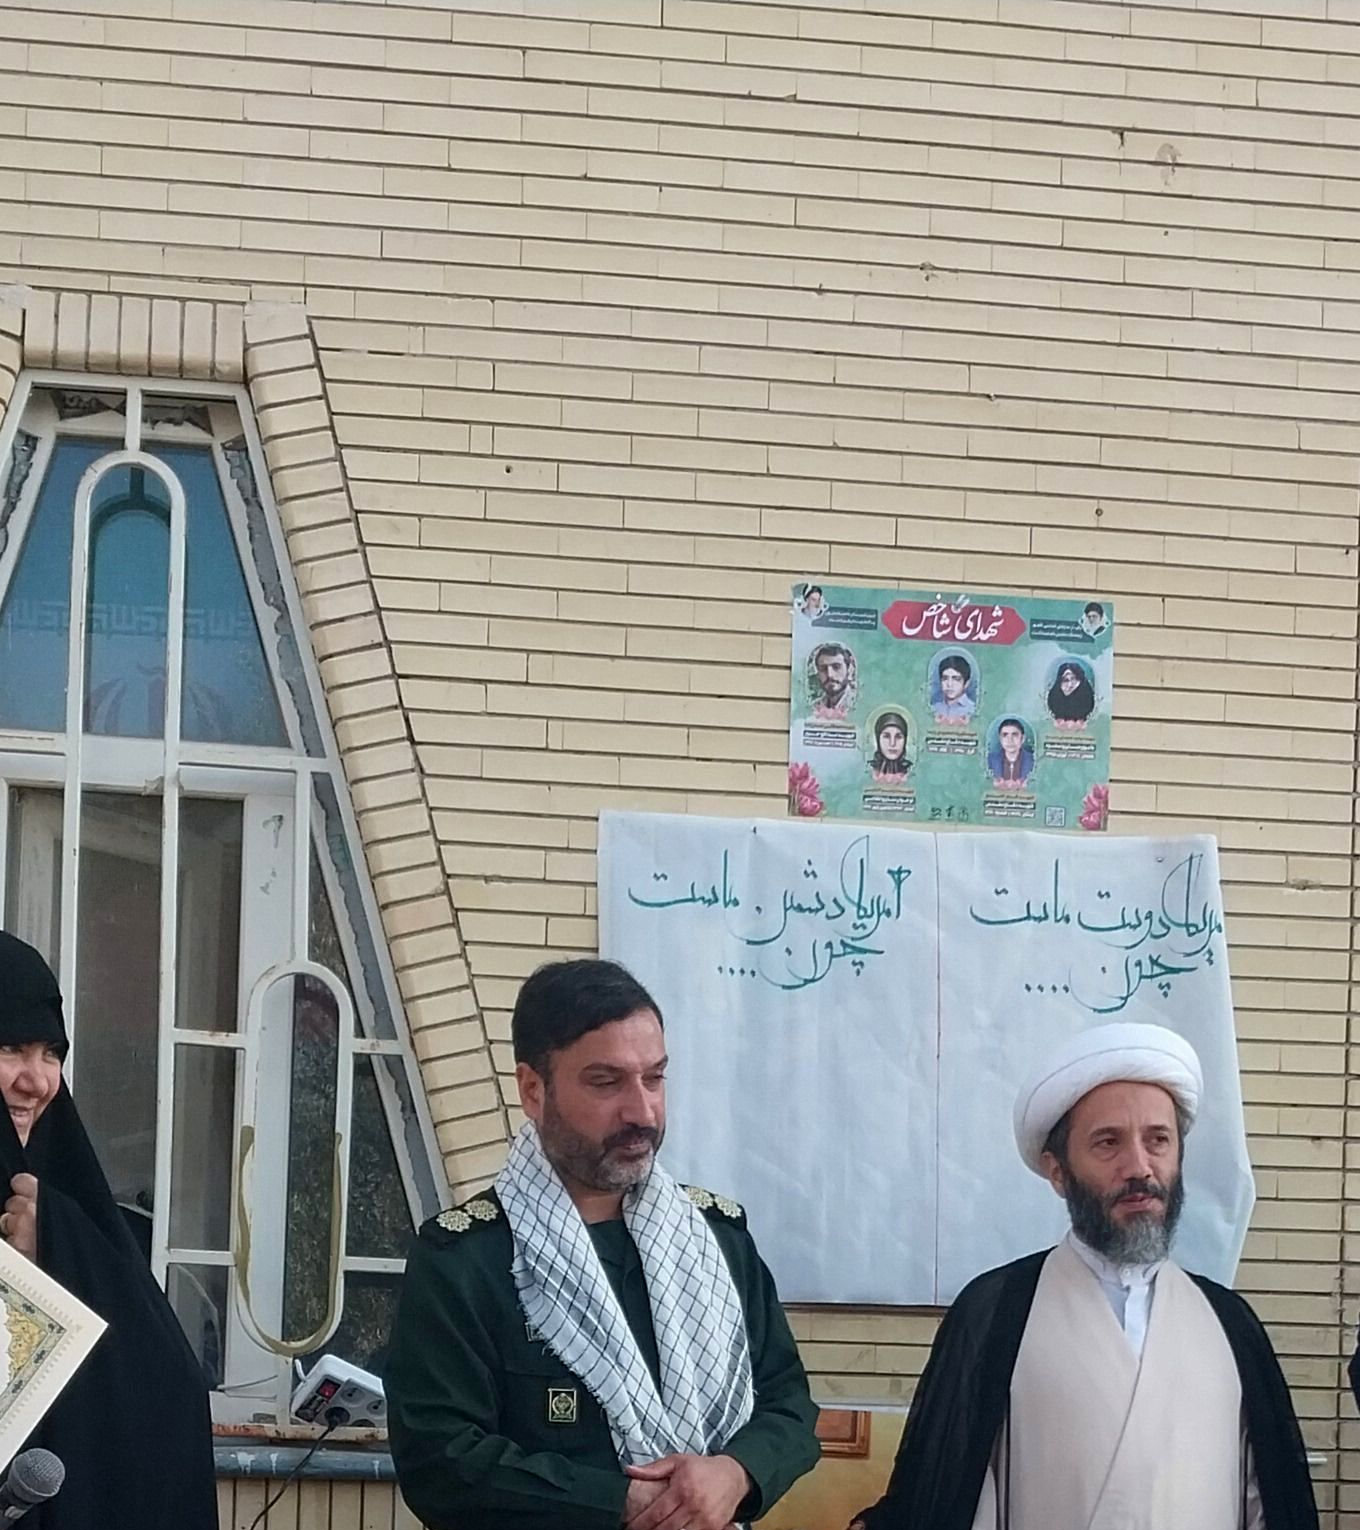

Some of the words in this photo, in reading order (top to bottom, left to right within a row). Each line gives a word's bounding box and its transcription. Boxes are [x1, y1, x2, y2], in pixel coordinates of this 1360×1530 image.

[902, 593, 952, 639] شاخص
[954, 604, 1004, 640] شهدای
[628, 850, 740, 908] ماست
[726, 859, 846, 945] دشمن
[970, 858, 1071, 926] ماست
[1162, 853, 1223, 965] مریکا
[1077, 889, 1171, 950] دوست
